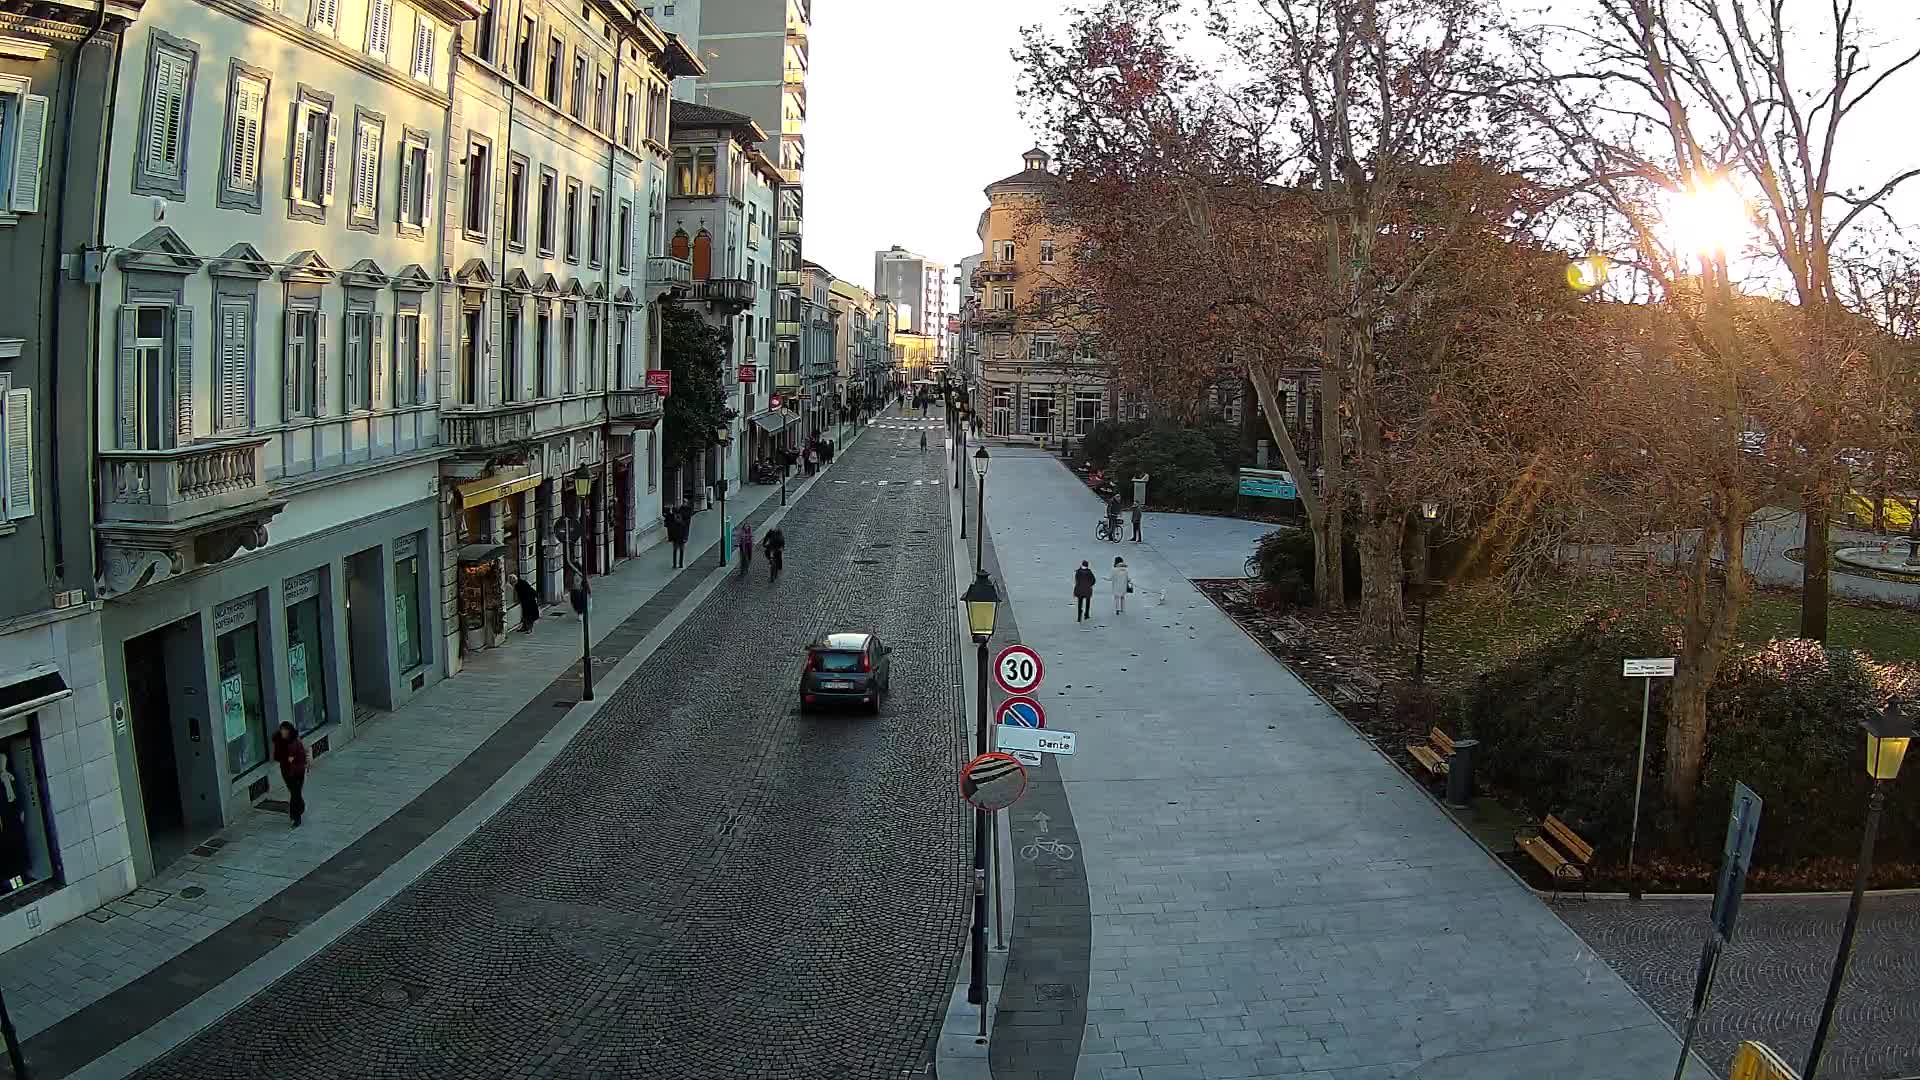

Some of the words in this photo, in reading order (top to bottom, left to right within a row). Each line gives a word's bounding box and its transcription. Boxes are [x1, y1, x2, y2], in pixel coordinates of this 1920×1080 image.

[1006, 659, 1033, 681] 30
[223, 678, 240, 700] 130
[1039, 739, 1070, 750] Dante
